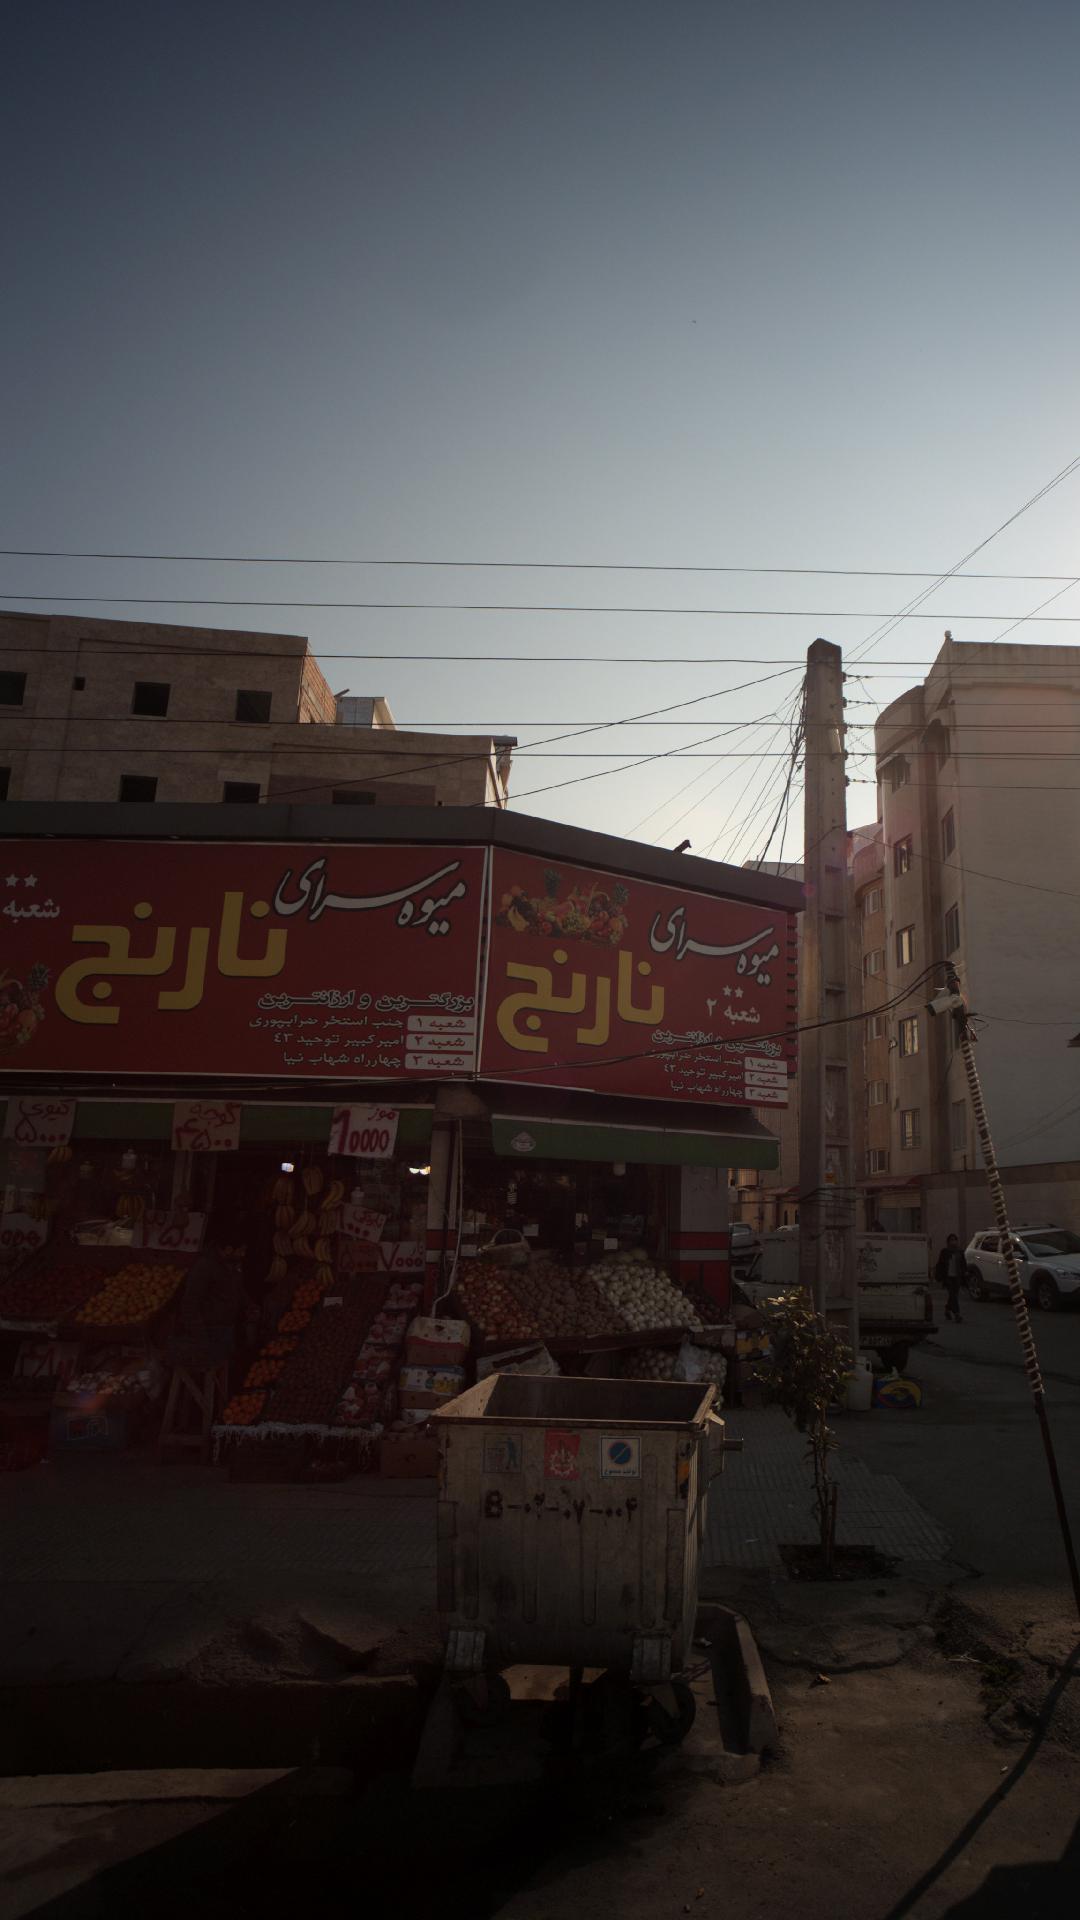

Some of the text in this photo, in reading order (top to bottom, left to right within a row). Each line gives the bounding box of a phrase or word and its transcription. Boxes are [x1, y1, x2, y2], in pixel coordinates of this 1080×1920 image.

[273, 856, 468, 936] میوه سرای
[2, 898, 61, 924] شعبه
[649, 904, 780, 986] میوه سرای
[55, 890, 289, 1025] نارنج
[357, 991, 372, 1010] و
[496, 949, 665, 1053] نارنج
[321, 1014, 368, 1029] استخر
[723, 1003, 760, 1026] شعبه
[371, 1018, 404, 1030] جنب
[429, 1019, 466, 1031] شعبه
[296, 1033, 340, 1047] توحید
[428, 1037, 466, 1049] شعبه
[427, 1056, 464, 1068] شعبه
[367, 1107, 396, 1121] موز
